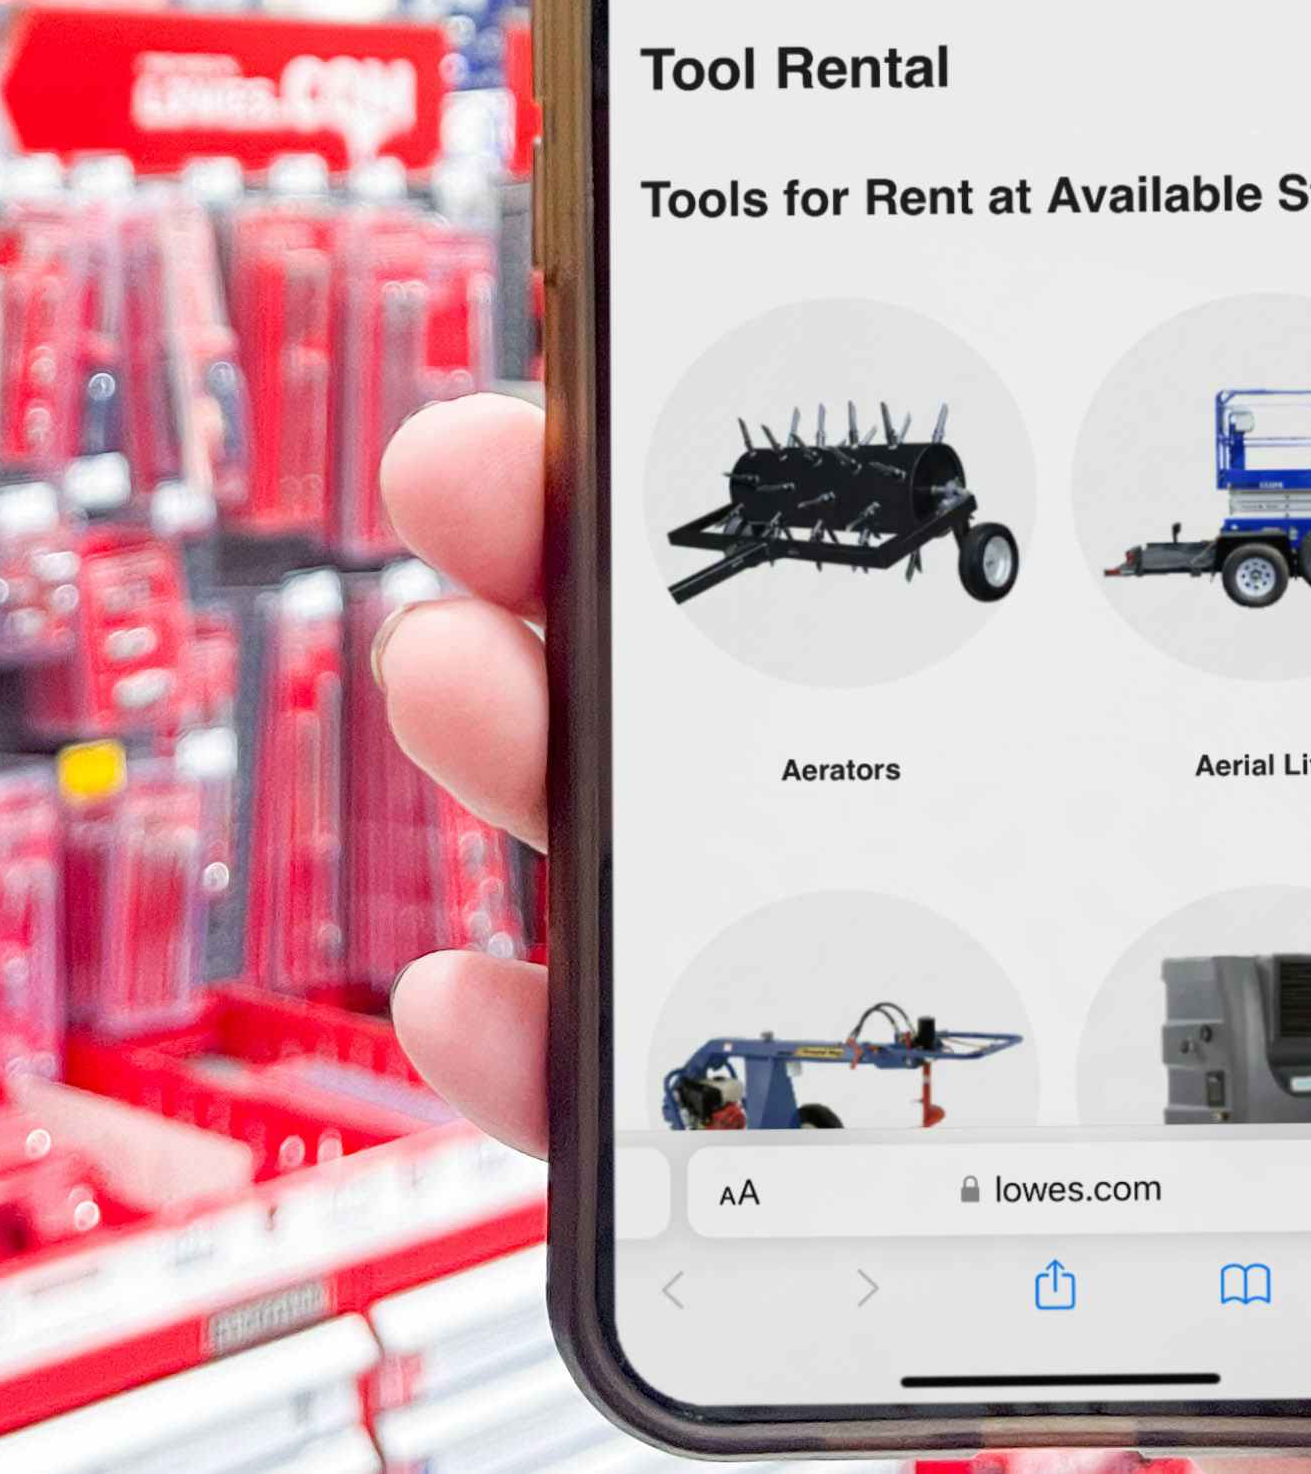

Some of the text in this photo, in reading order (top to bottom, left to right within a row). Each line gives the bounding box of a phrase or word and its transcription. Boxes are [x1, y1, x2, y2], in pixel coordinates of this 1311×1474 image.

[640, 45, 947, 91] Tool Rental
[641, 180, 768, 218] Tools
[783, 179, 849, 217] for
[867, 179, 973, 216] Rent
[989, 180, 1031, 215] at
[1048, 175, 1262, 213] Available
[782, 759, 900, 781] Aerators
[1196, 754, 1274, 776] Aerial
[997, 1176, 1161, 1202] lowes.com
